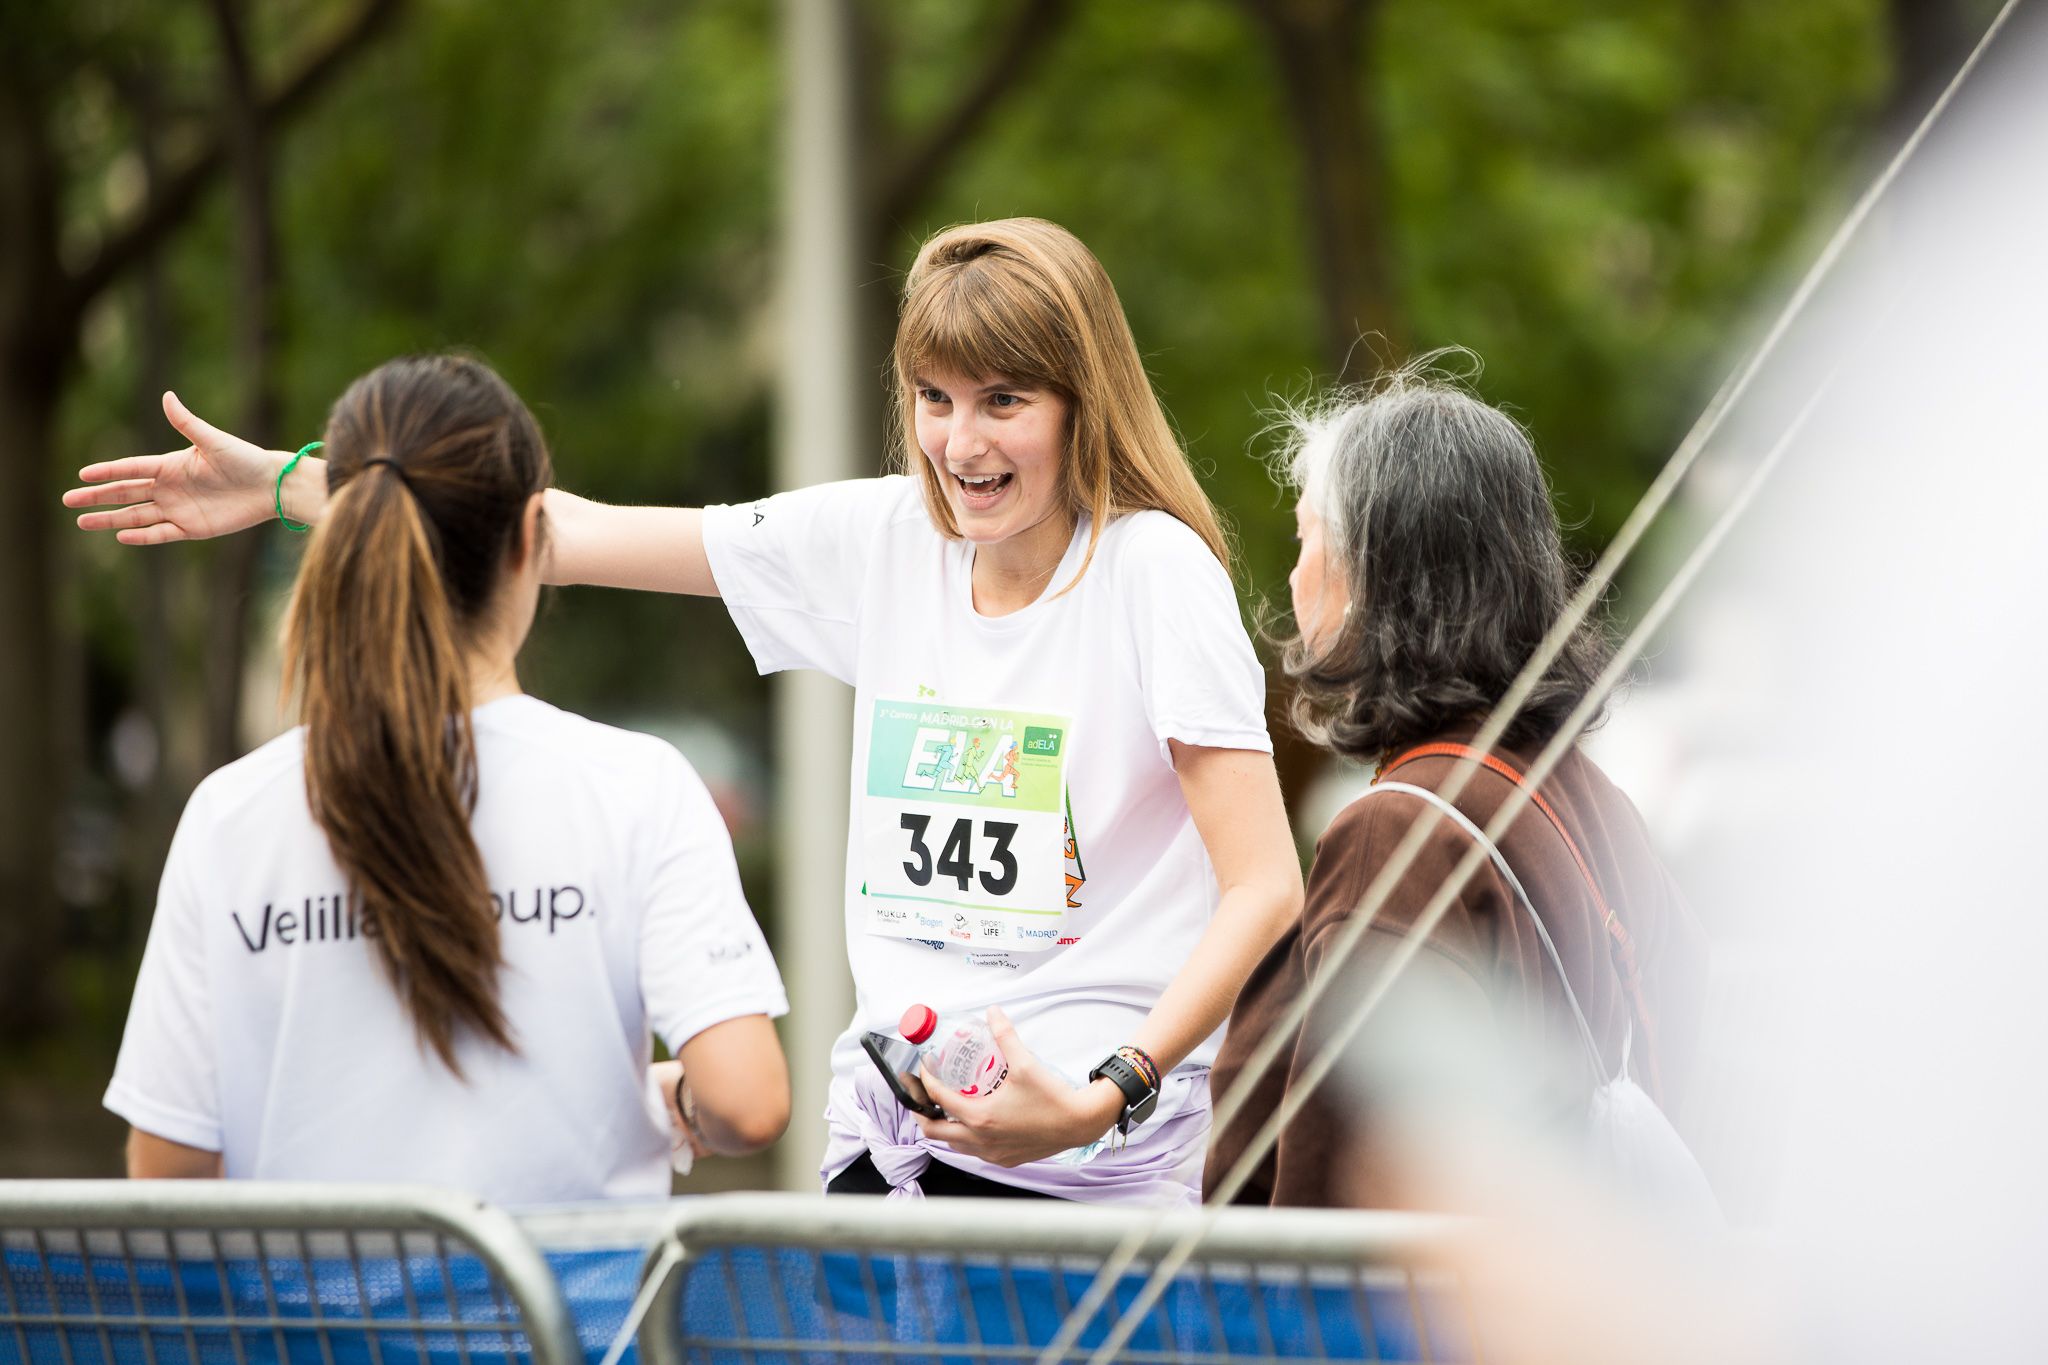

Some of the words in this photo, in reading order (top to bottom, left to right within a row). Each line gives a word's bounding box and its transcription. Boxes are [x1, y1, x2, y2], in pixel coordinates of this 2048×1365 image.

[920, 711, 969, 727] MADRID
[1000, 718, 1014, 730] LA
[1028, 739, 1055, 751] adELA
[902, 727, 1016, 798] ELA
[900, 812, 1019, 896] 343
[877, 909, 907, 919] MUKUA
[920, 916, 943, 928] Biogen
[983, 928, 999, 937] LIFE
[1026, 929, 1058, 939] MADRID
